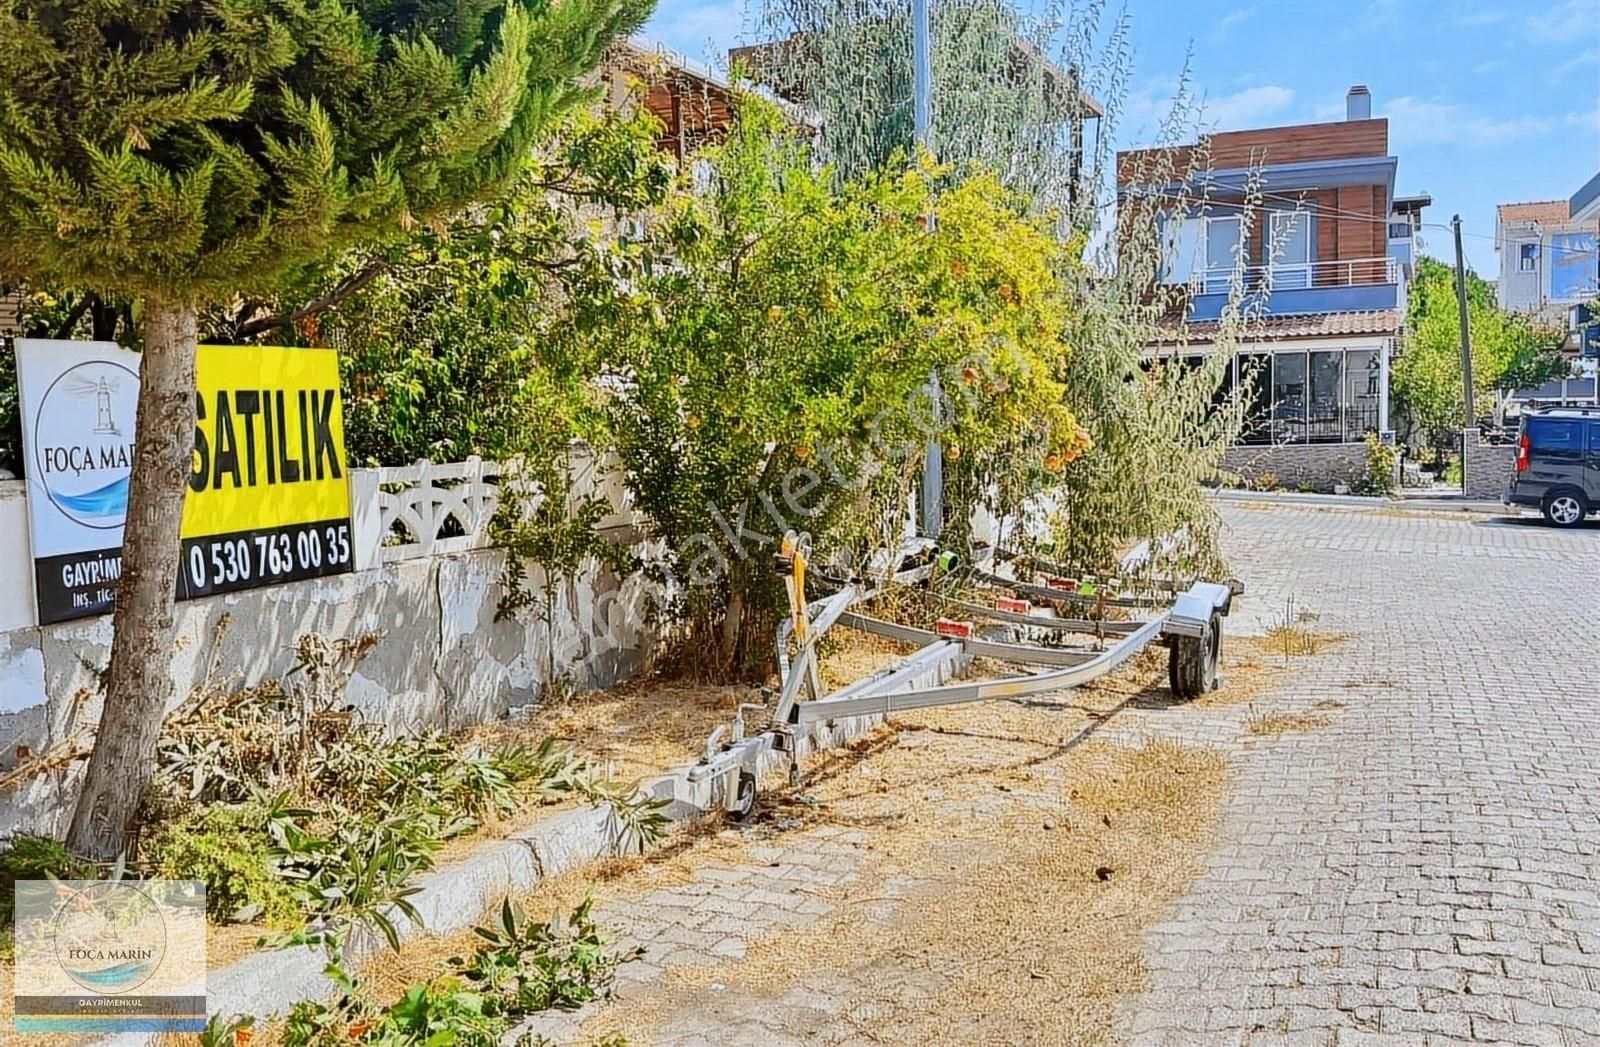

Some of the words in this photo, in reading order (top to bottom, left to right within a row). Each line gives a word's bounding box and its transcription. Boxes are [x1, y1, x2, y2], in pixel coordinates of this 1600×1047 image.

[44, 446, 95, 477] FOÇA
[189, 389, 342, 492] SATILIK
[190, 545, 205, 588] 0
[211, 539, 250, 585] 530
[255, 533, 293, 577] 763
[297, 529, 322, 569] 00
[326, 525, 350, 563] 35
